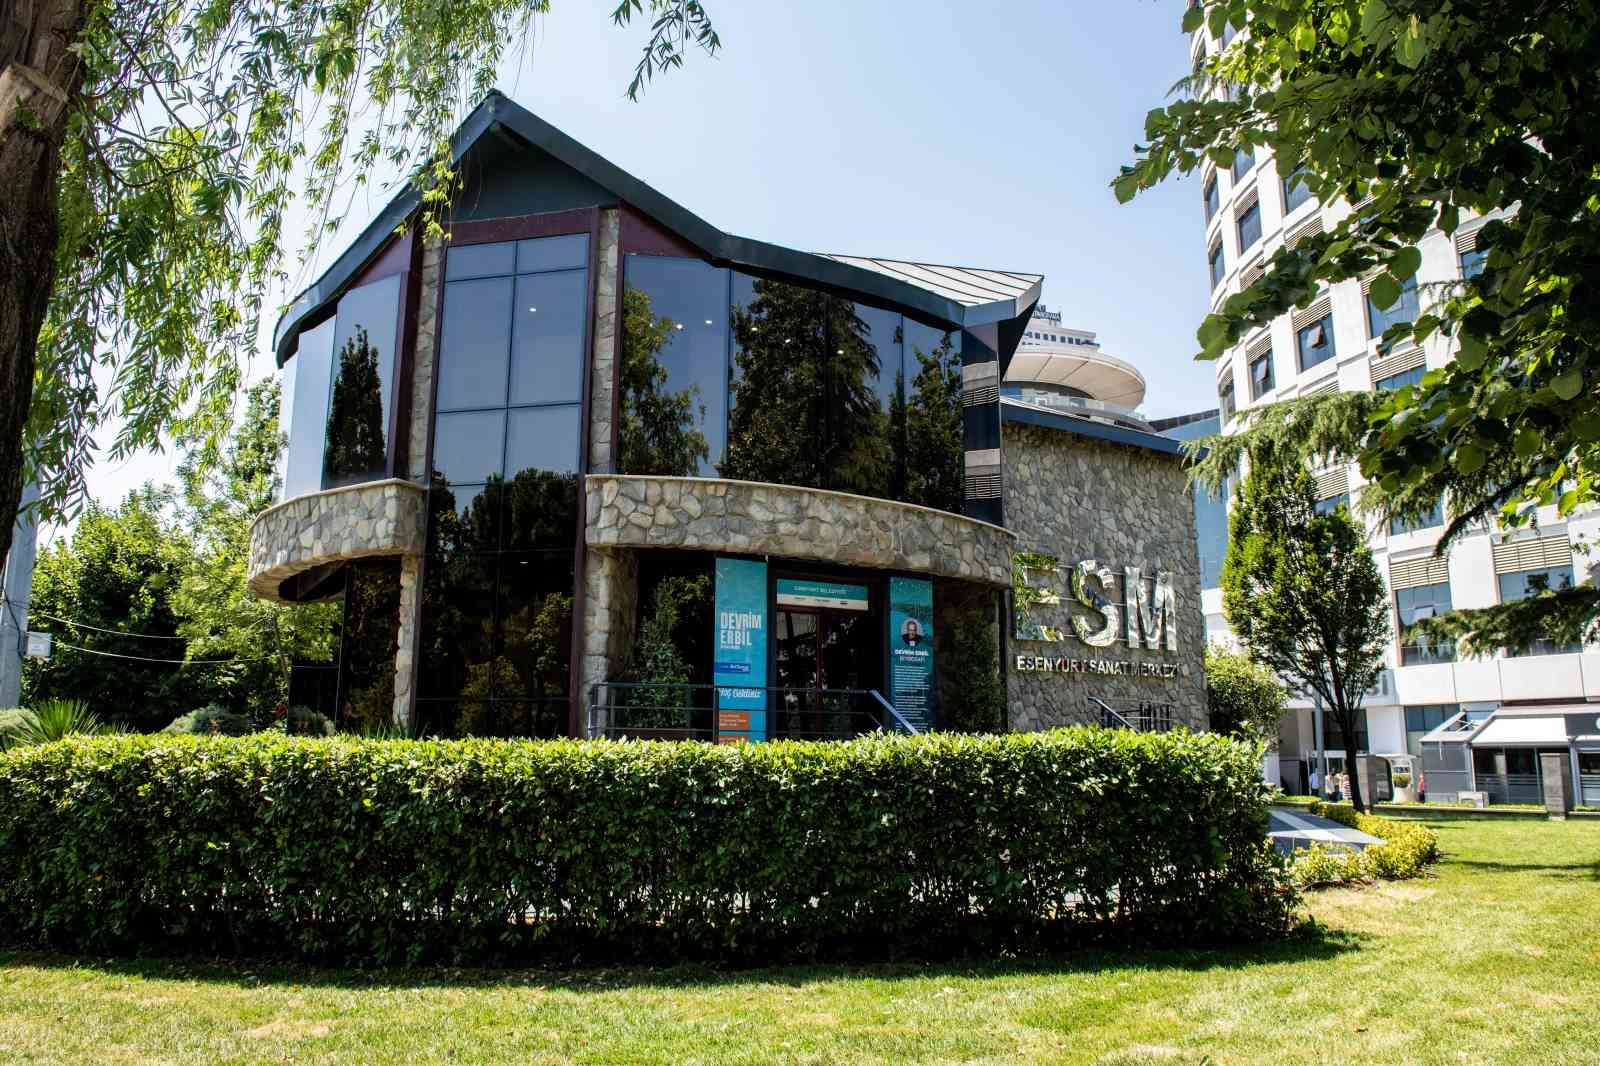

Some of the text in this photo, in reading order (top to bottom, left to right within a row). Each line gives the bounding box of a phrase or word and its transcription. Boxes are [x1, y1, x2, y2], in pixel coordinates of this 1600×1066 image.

[1012, 552, 1177, 651] ESM
[720, 610, 762, 629] DEVRİM
[1016, 655, 1087, 673] ESENYURT
[1088, 660, 1129, 676] SANAT
